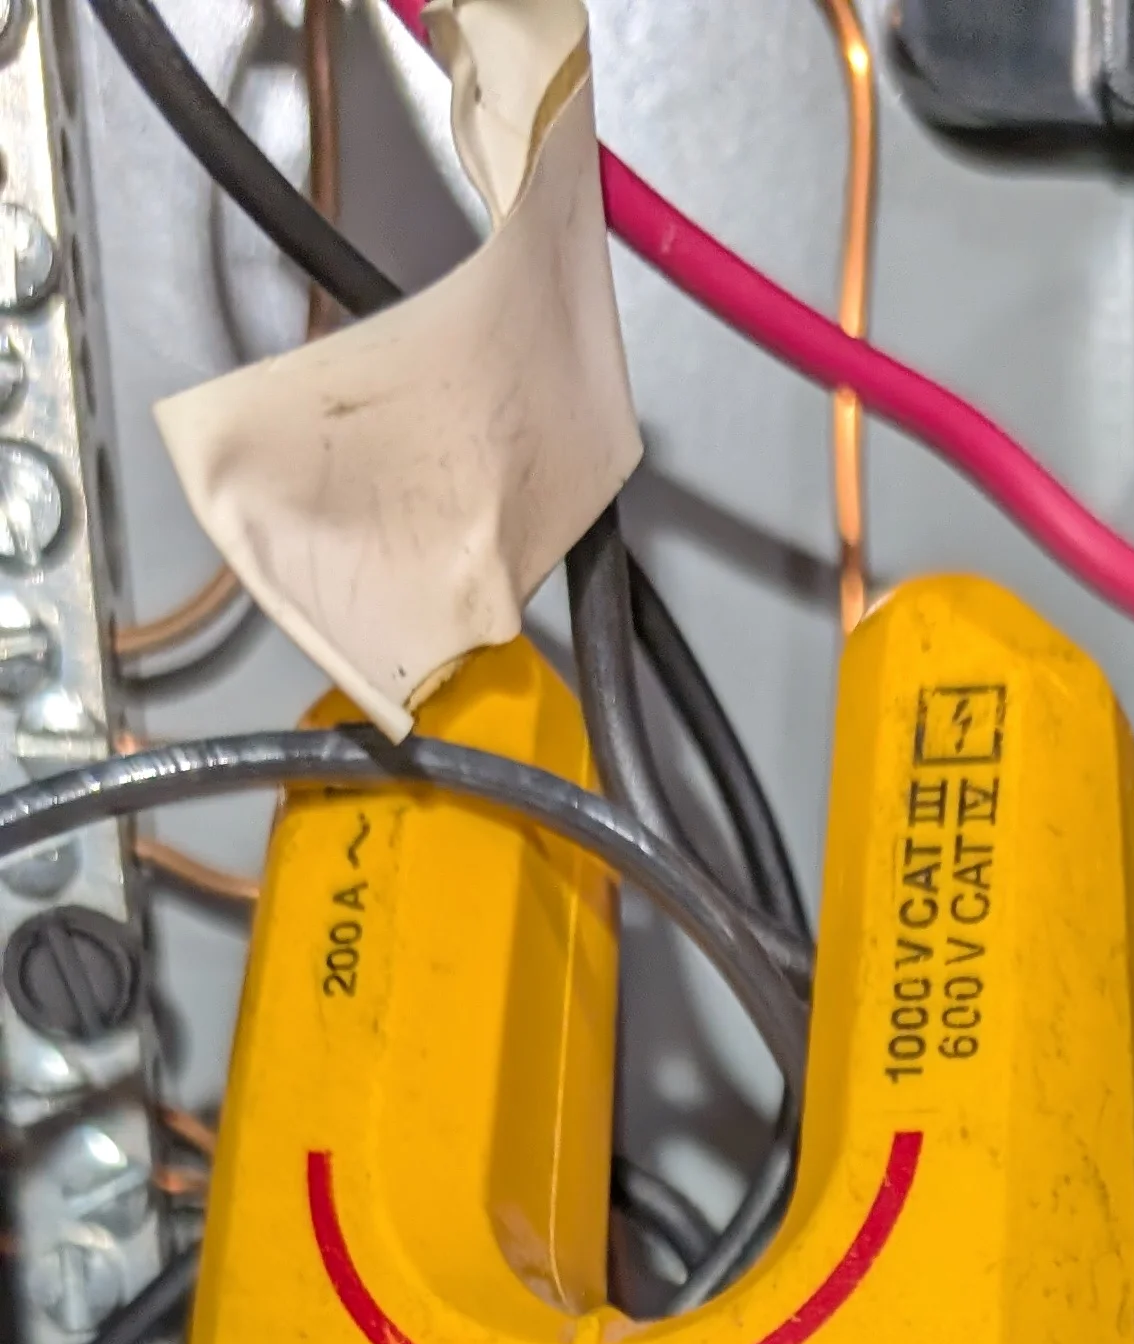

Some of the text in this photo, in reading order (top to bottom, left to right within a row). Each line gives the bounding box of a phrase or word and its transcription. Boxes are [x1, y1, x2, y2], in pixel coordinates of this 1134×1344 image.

[322, 880, 369, 998] 200 A
[884, 776, 948, 1087] 1000 V CAT III
[938, 777, 999, 1061] 600 V CAT IV
